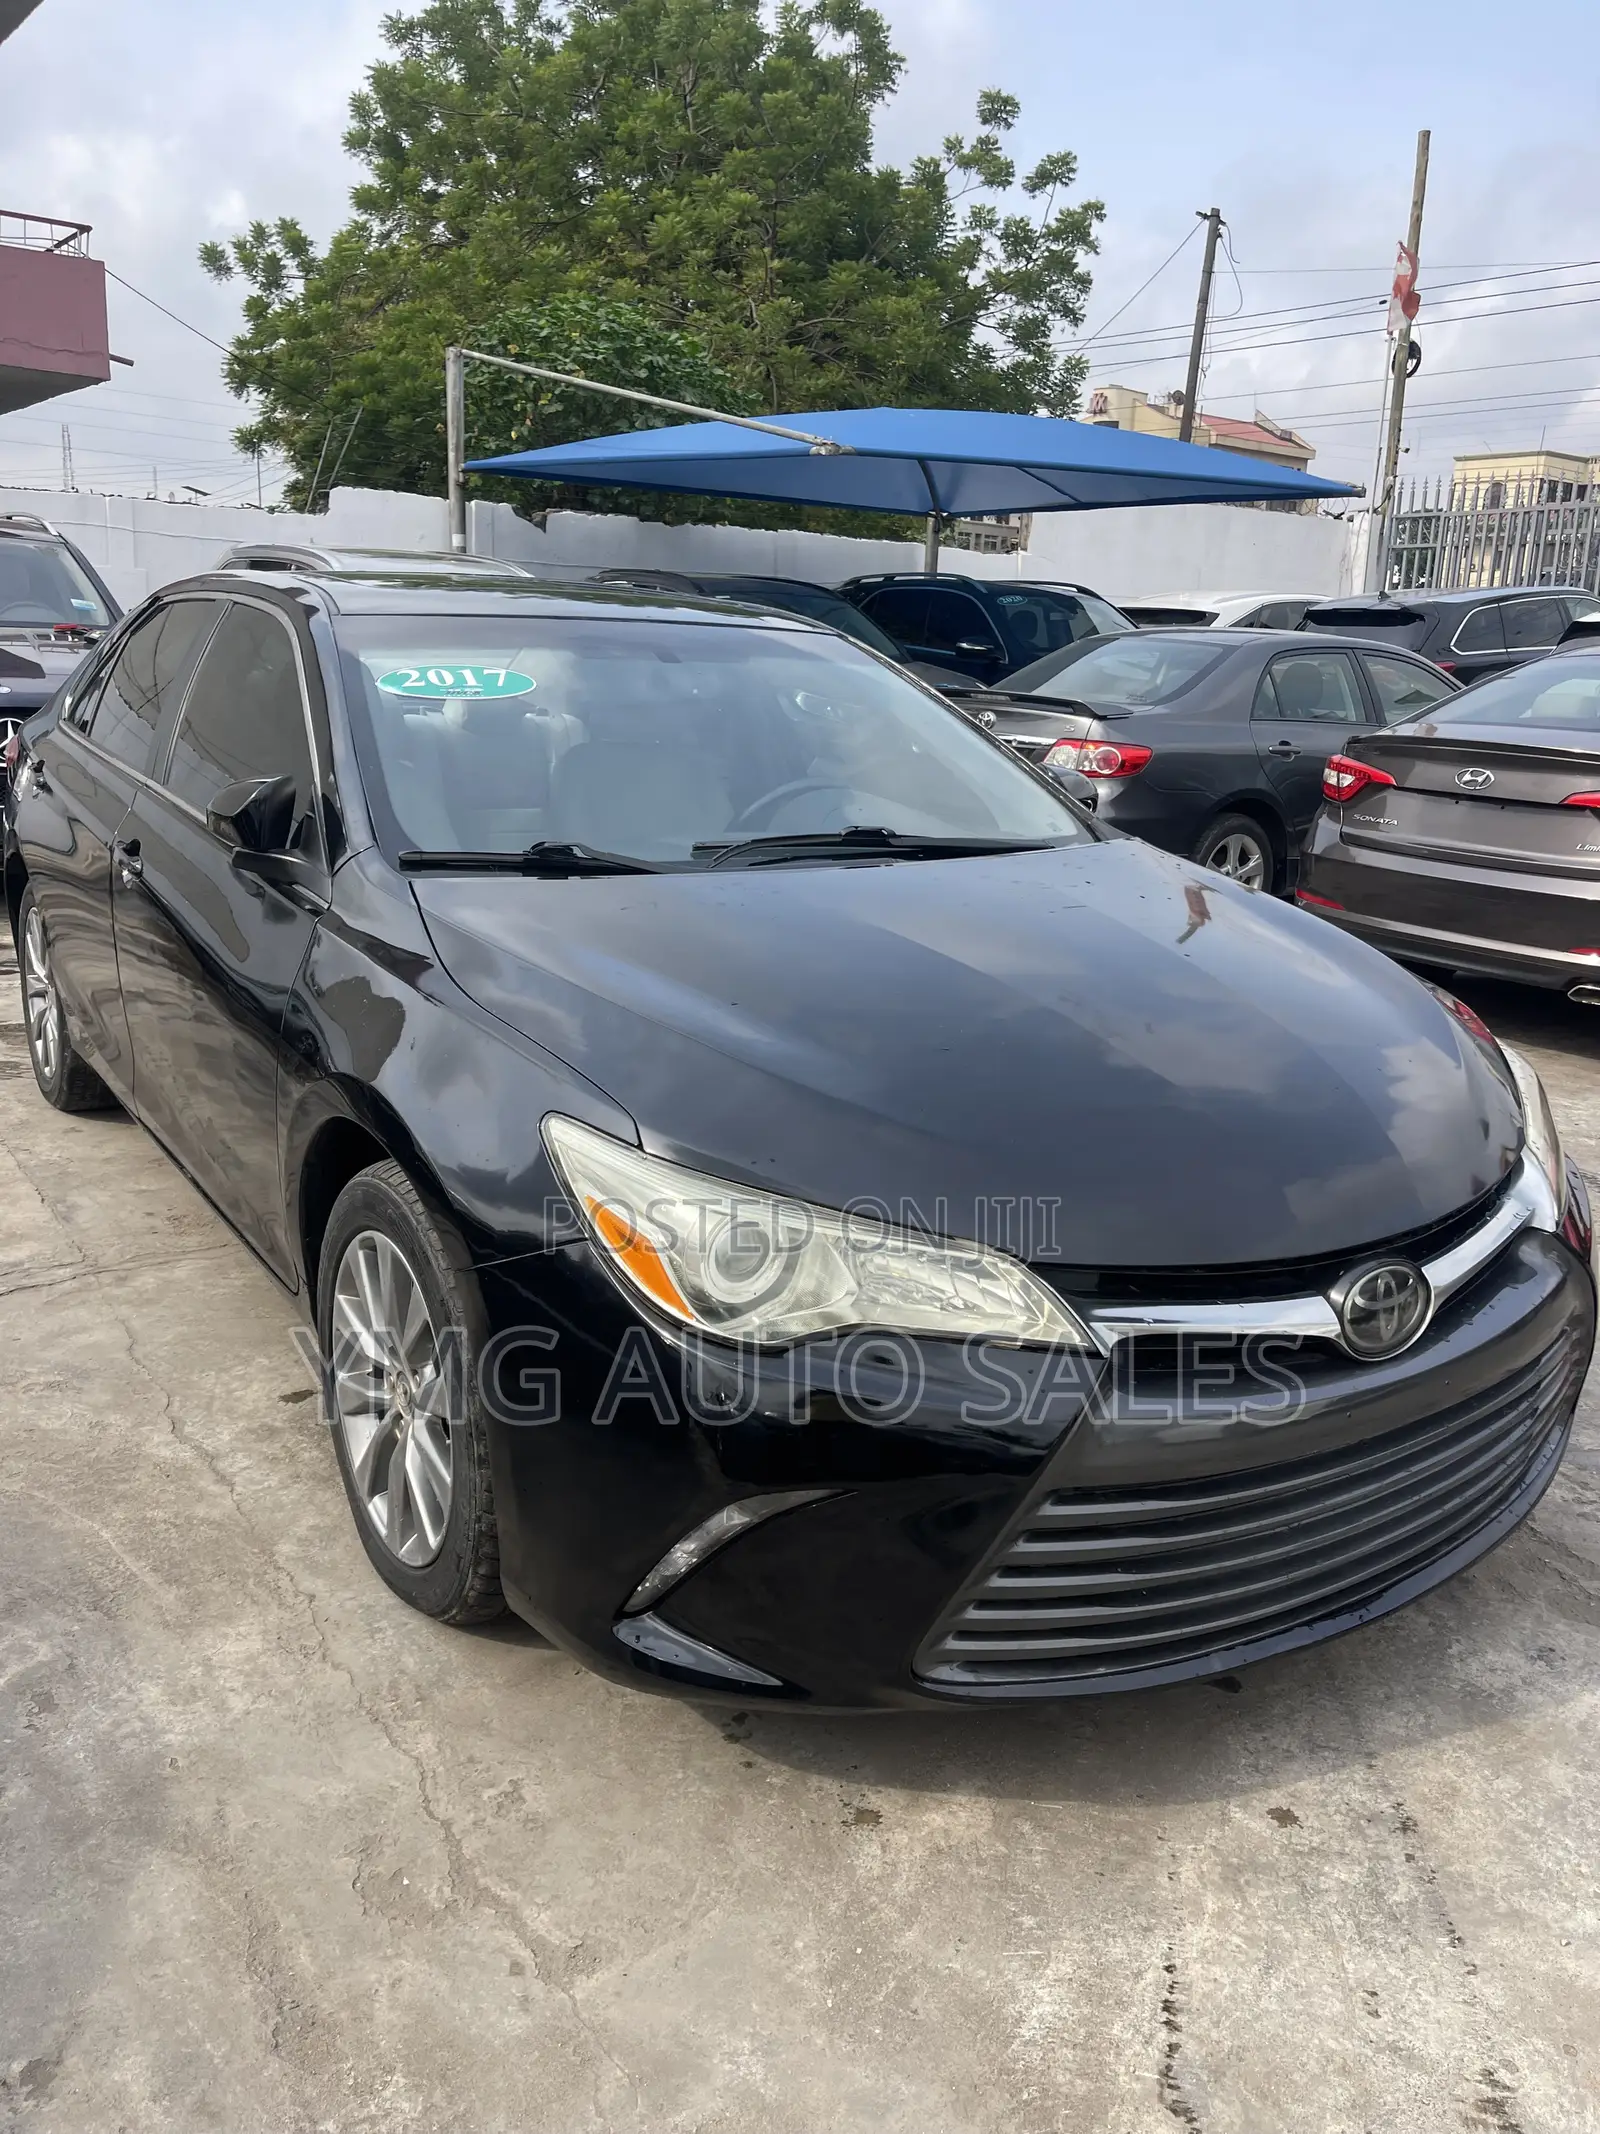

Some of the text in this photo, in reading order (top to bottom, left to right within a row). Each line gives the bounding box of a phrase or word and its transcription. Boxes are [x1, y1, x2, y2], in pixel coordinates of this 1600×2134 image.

[396, 668, 507, 687] 2017
[1063, 724, 1076, 733] S
[1352, 812, 1399, 826] SONATA
